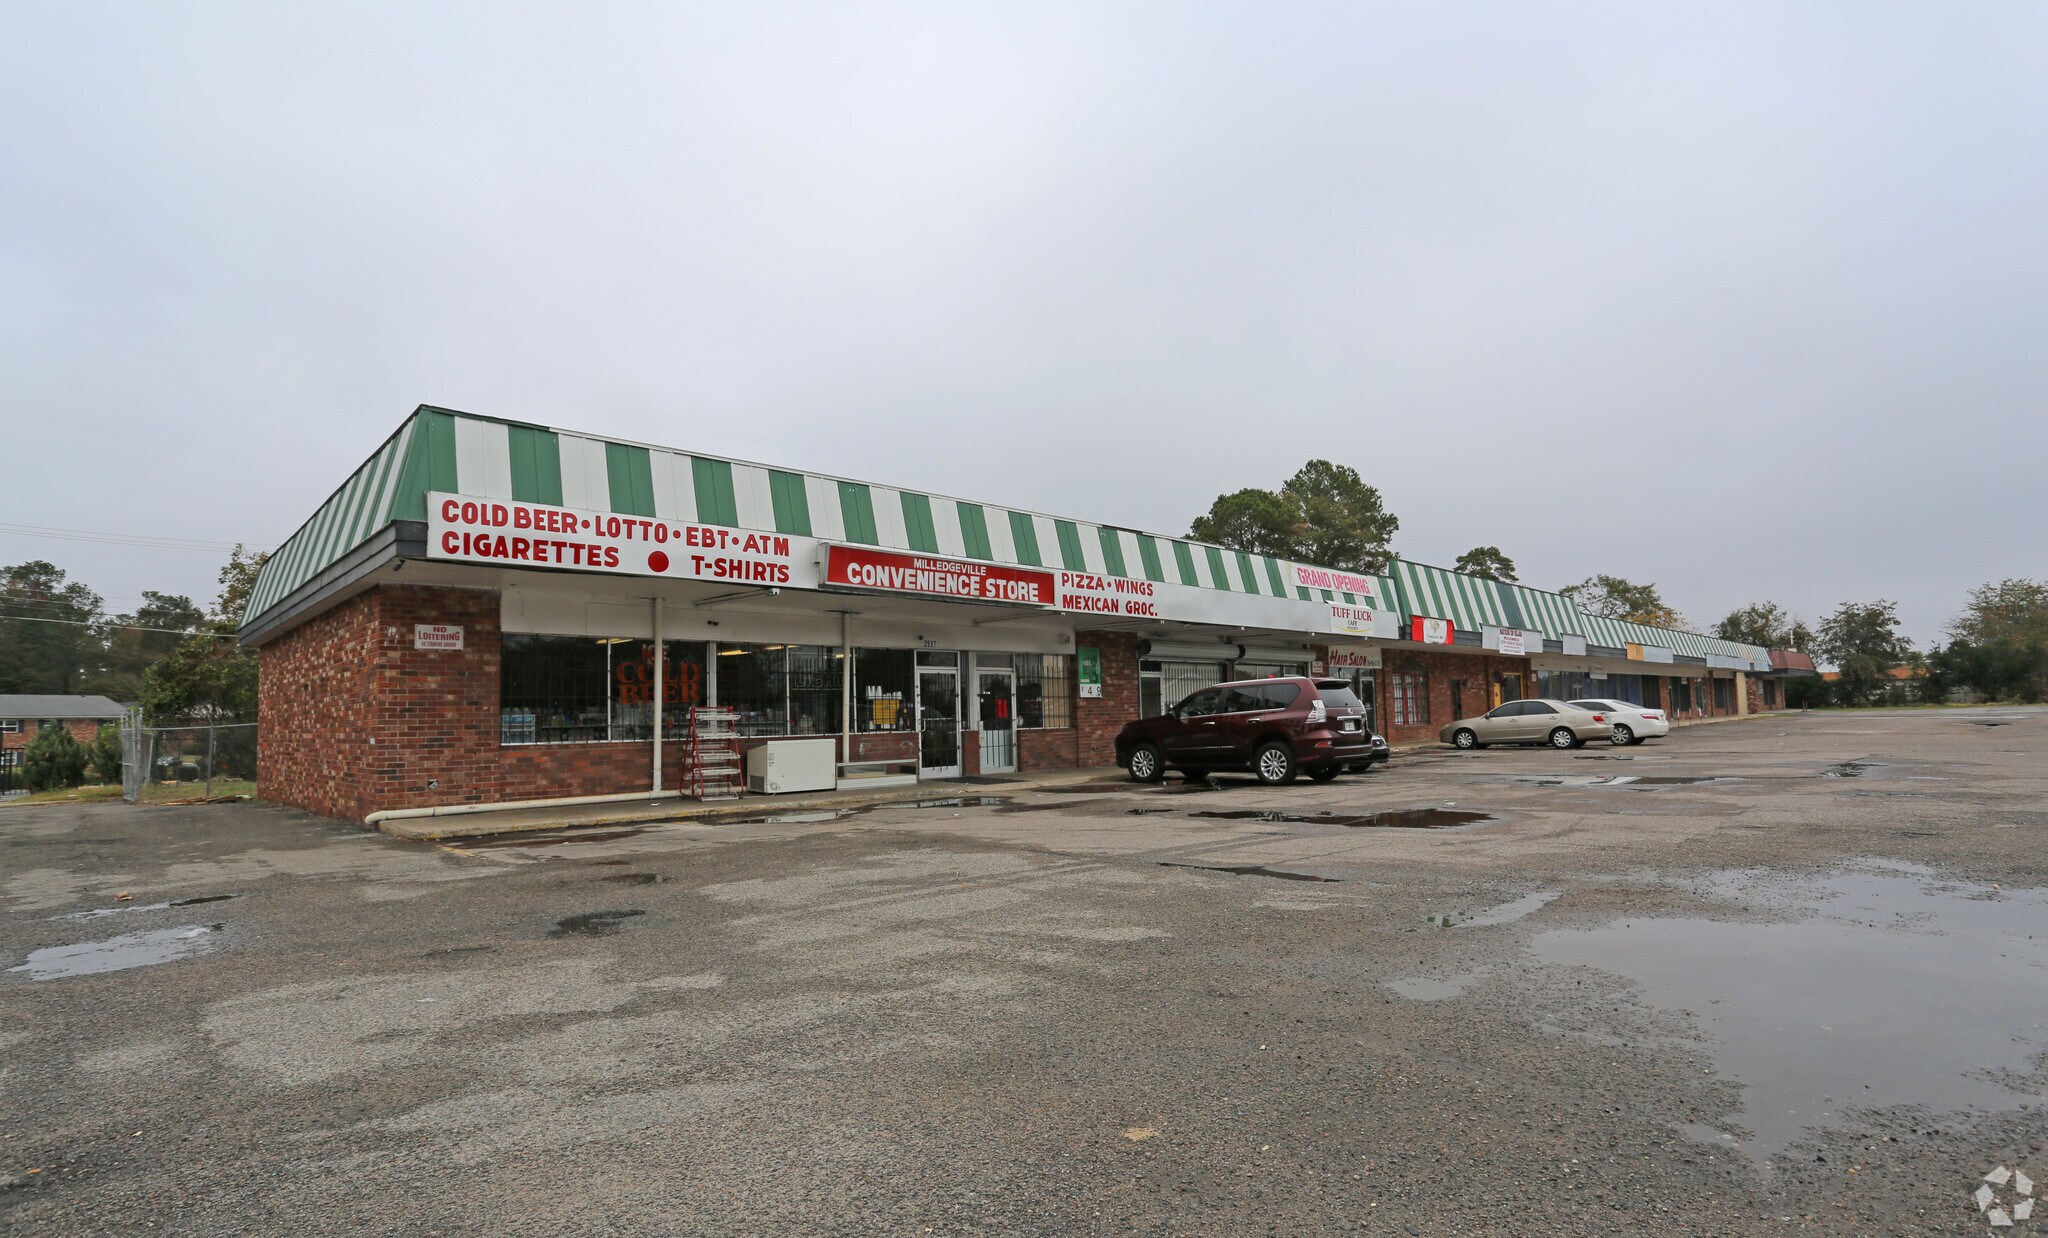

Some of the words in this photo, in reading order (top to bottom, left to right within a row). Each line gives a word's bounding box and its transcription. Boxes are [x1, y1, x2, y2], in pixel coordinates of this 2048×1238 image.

[442, 499, 508, 527] COLD
[514, 506, 578, 534] BEER
[595, 515, 668, 544] LOTTO
[686, 526, 729, 550] EBT
[742, 533, 790, 557] ATM
[442, 530, 619, 568] CIGARETTES
[691, 555, 790, 583] T-SHIRTS
[913, 558, 987, 576] MILLEDGEVILLE
[847, 562, 980, 598] CONVENIENCE
[986, 578, 1039, 601] STORE
[1061, 572, 1105, 592] PIZZA
[1113, 579, 1154, 597] WINGS
[1296, 567, 1332, 589] GRAND
[1332, 573, 1371, 594] OPENING
[1062, 594, 1119, 614] MEXICAN
[1125, 600, 1158, 617] GROC.
[1331, 606, 1350, 619] TUFF
[1353, 609, 1372, 622] LUCK
[418, 630, 460, 641] LOITERING
[1329, 649, 1348, 666] HAIR
[1348, 652, 1367, 666] SALON
[616, 661, 700, 683] COLD
[619, 683, 700, 705] BEER
